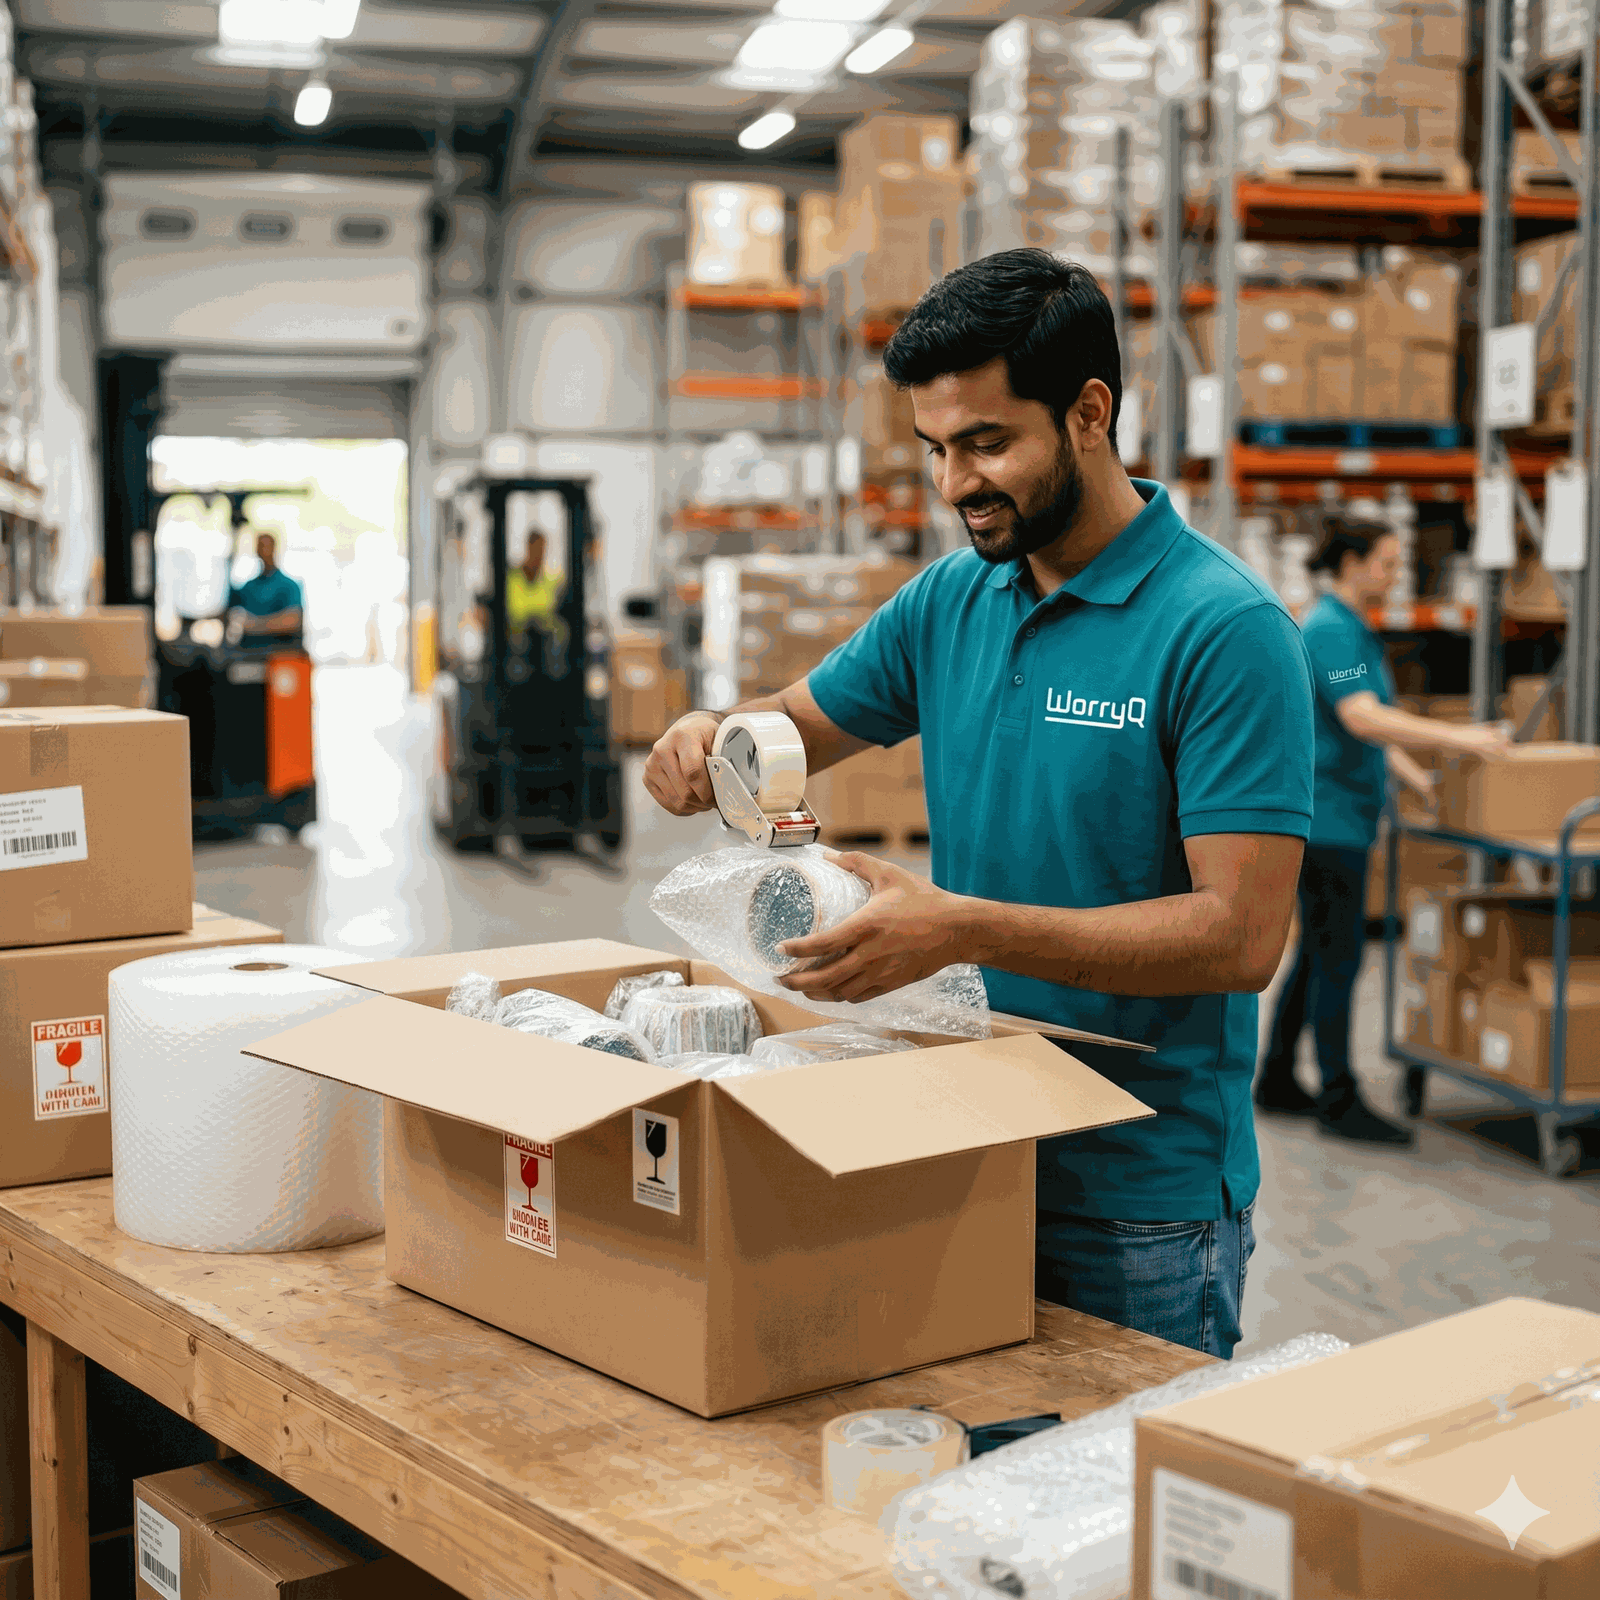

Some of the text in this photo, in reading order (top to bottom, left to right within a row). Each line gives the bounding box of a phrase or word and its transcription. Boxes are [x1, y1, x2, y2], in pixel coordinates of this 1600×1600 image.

[1328, 663, 1368, 684] WorryQ
[1045, 687, 1146, 729] WorryQ
[37, 1020, 100, 1040] FRAGILE
[41, 1100, 70, 1112] WITH
[509, 1221, 529, 1239] WITH
